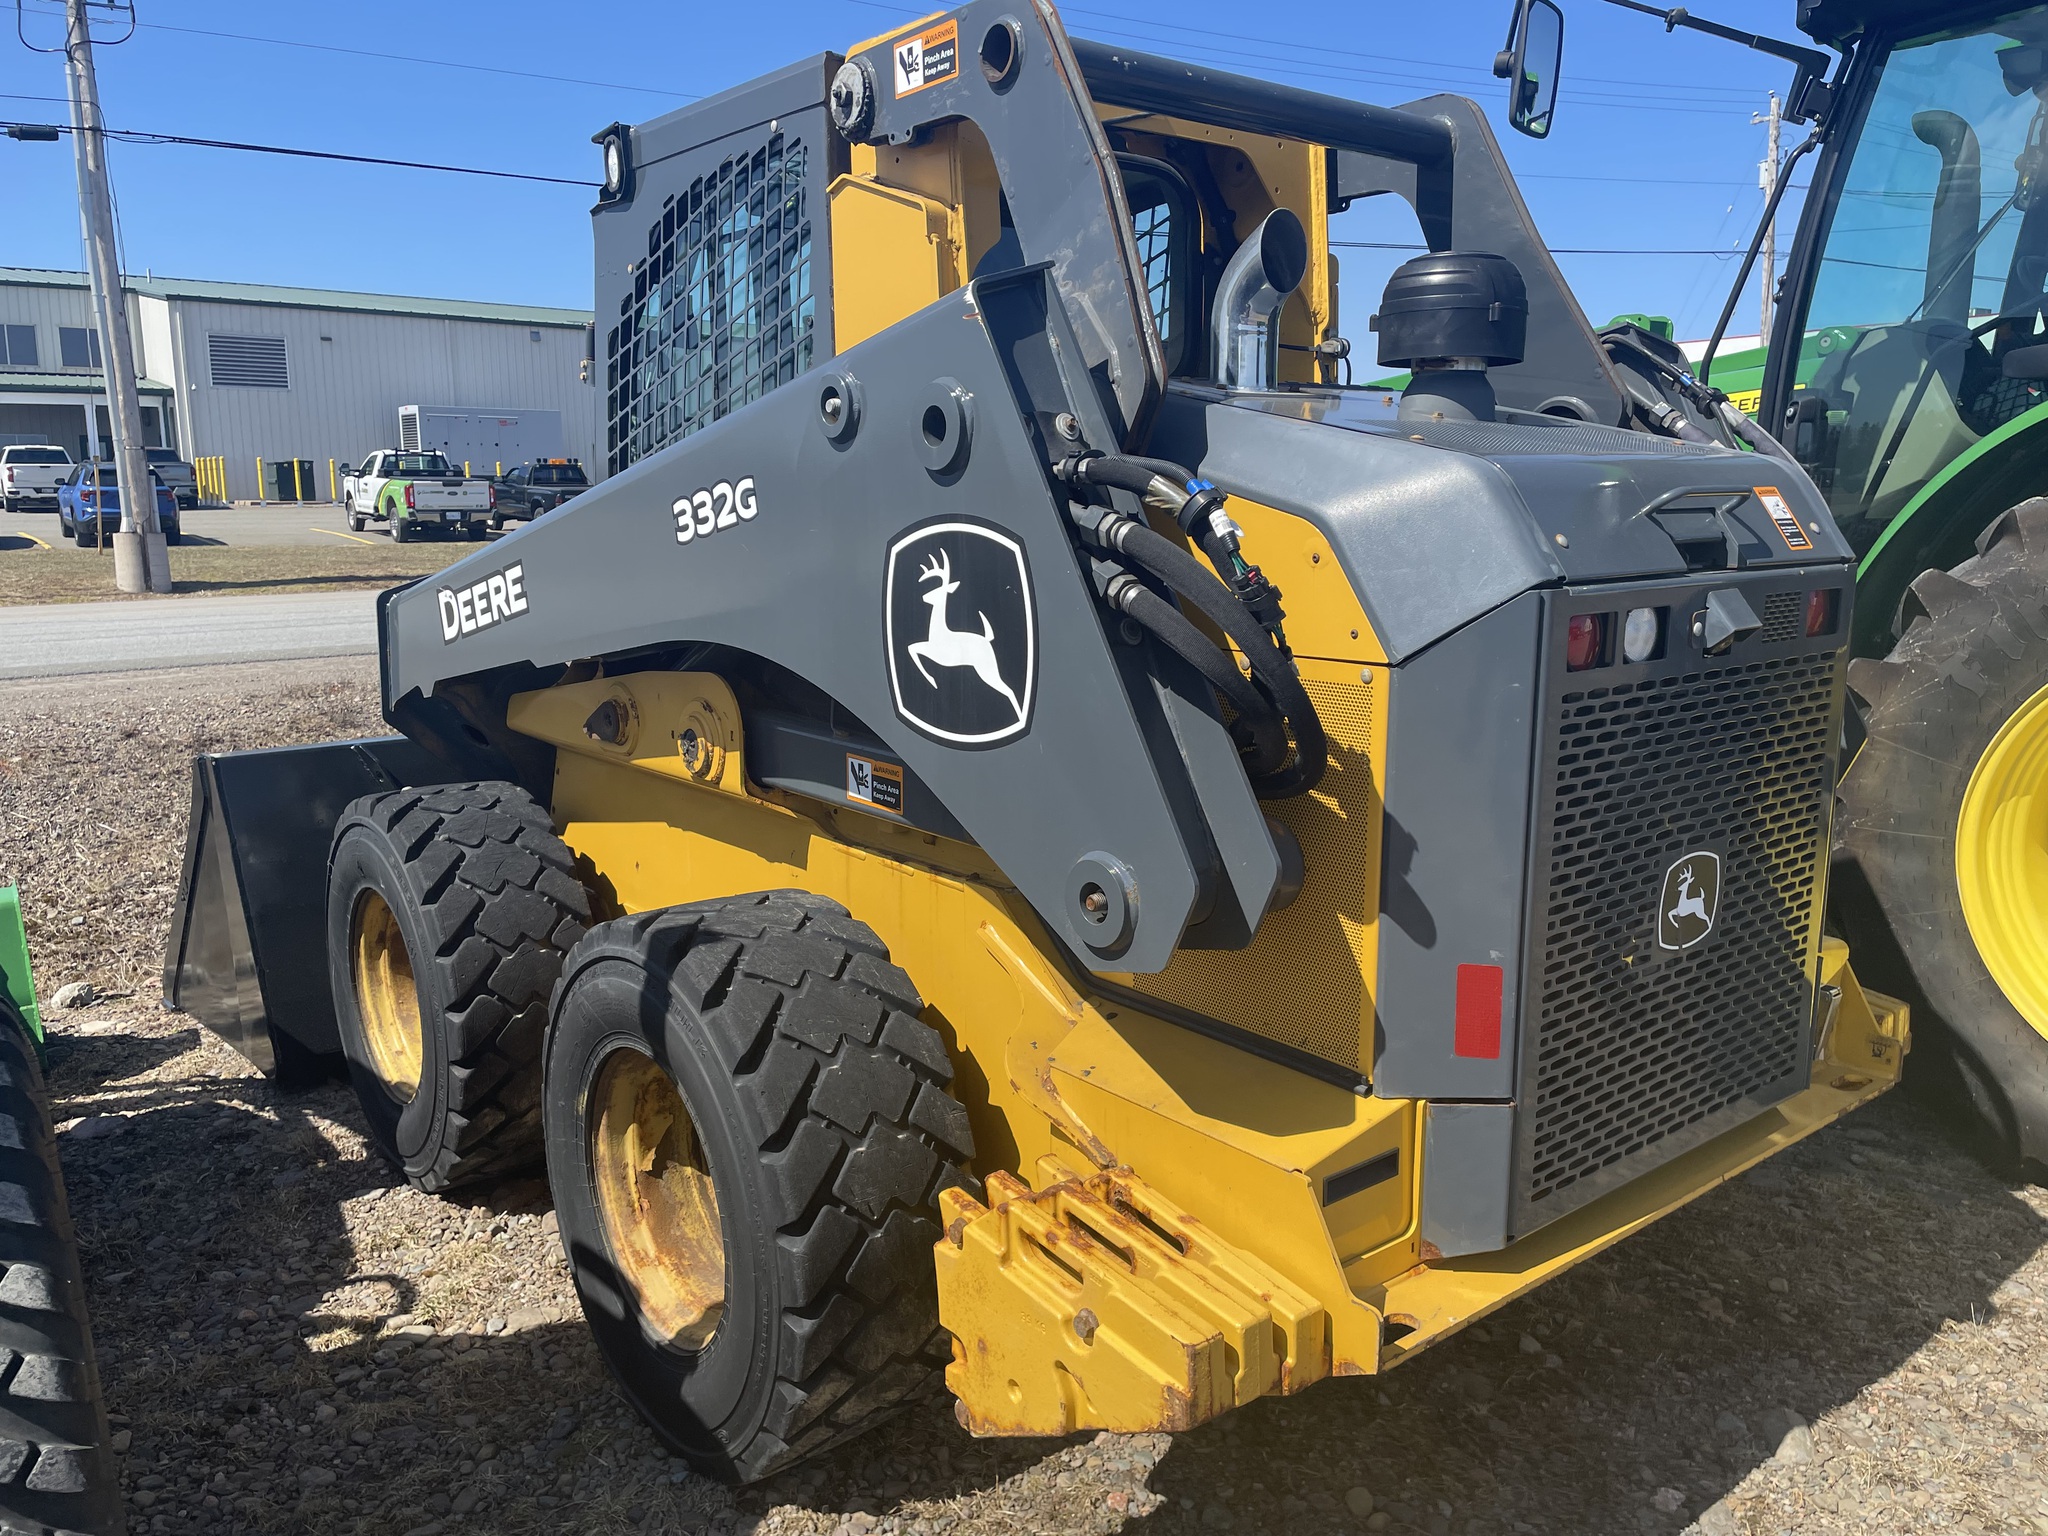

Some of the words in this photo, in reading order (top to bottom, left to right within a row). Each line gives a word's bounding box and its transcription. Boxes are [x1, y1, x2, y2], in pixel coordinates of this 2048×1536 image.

[929, 26, 954, 43] WARNING
[924, 52, 940, 65] Pinch
[940, 48, 954, 59] Area
[924, 66, 937, 76] Keep
[937, 62, 950, 72] Away
[672, 477, 758, 544] 332G
[437, 564, 528, 642] DEERE
[878, 765, 900, 778] WARNING
[873, 780, 887, 791] Pinch
[887, 785, 899, 795] Area
[873, 791, 884, 800] Keep
[884, 794, 896, 804] Away
